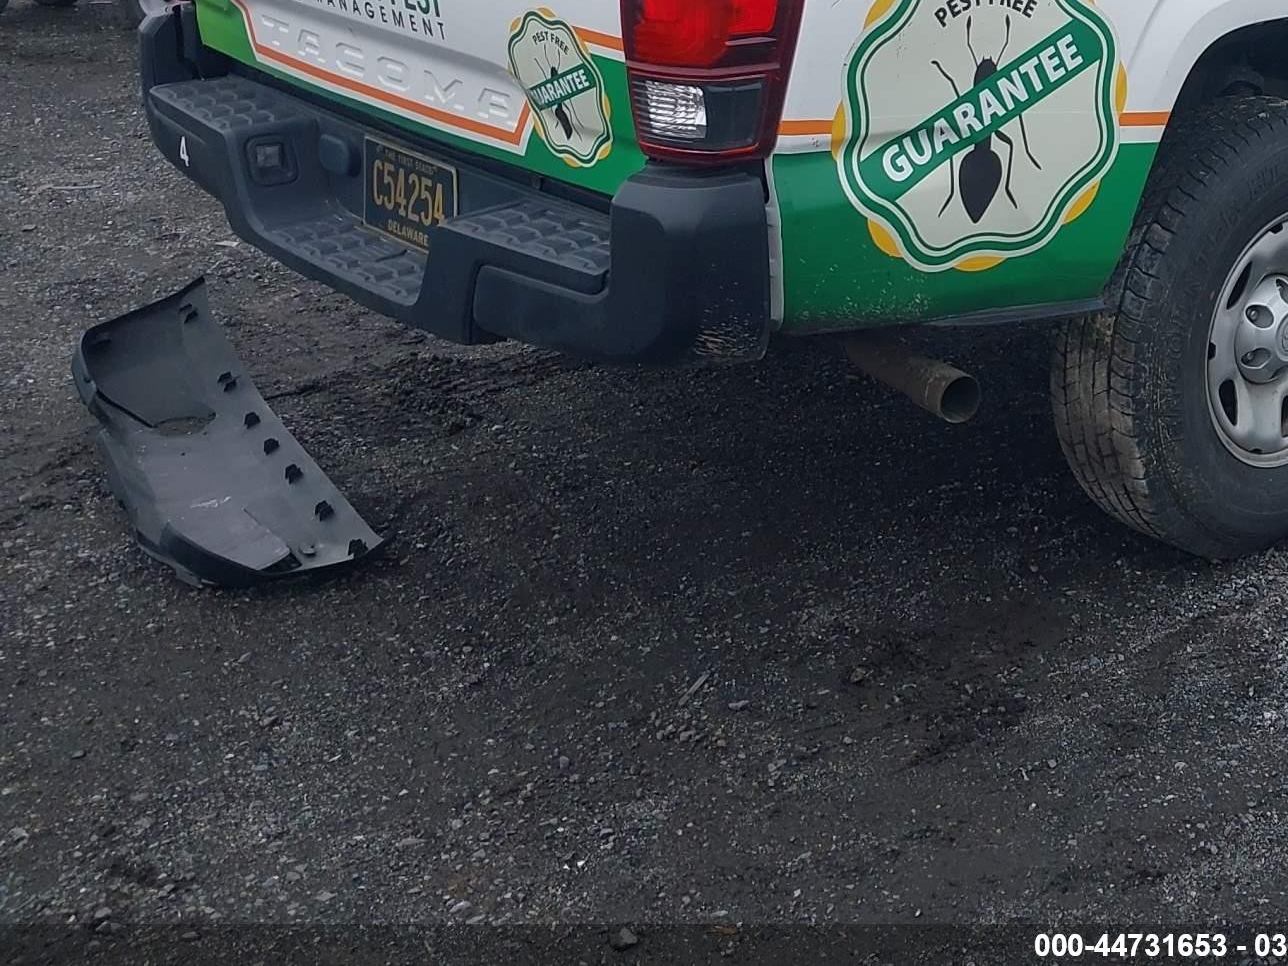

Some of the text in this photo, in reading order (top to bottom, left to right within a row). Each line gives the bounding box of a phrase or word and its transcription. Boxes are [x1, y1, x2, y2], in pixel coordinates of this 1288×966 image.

[532, 30, 569, 55] PEST FREE
[882, 33, 1084, 183] GUARANTEE
[373, 159, 446, 227] C54254
[387, 218, 430, 248] DELAWARE
